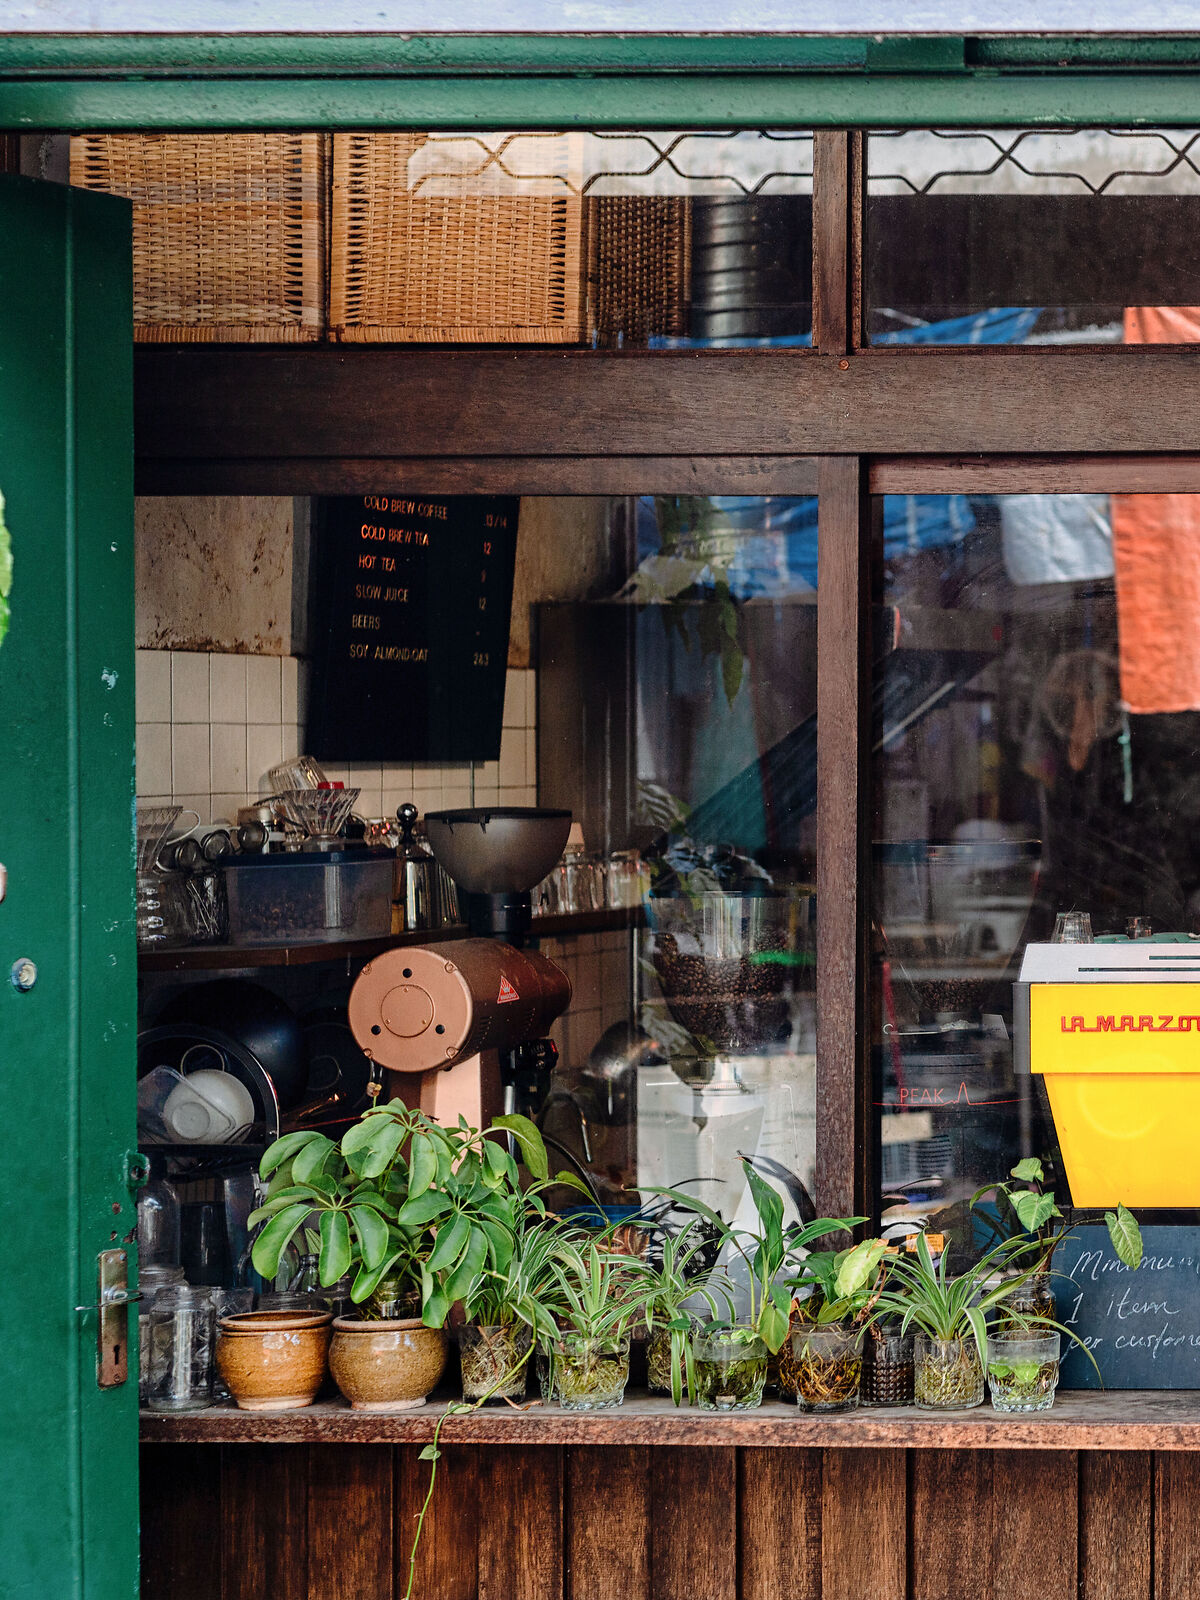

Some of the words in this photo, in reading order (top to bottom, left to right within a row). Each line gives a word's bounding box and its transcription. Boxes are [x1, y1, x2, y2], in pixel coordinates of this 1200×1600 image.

[364, 496, 388, 512] COLD
[391, 499, 415, 515] BREW
[418, 502, 448, 520] COFFEE
[361, 524, 385, 541] COLD
[388, 528, 412, 544] BREW
[415, 531, 430, 546] TEA
[359, 554, 376, 569] HOT
[381, 556, 396, 572] TEA
[355, 584, 381, 600] SLOW
[384, 587, 408, 603] JUICE
[352, 614, 380, 630] BEERS
[350, 643, 368, 658] SOY
[899, 1087, 945, 1104] PEAK
[1064, 1292, 1084, 1325] 1
[1106, 1287, 1181, 1320] item
